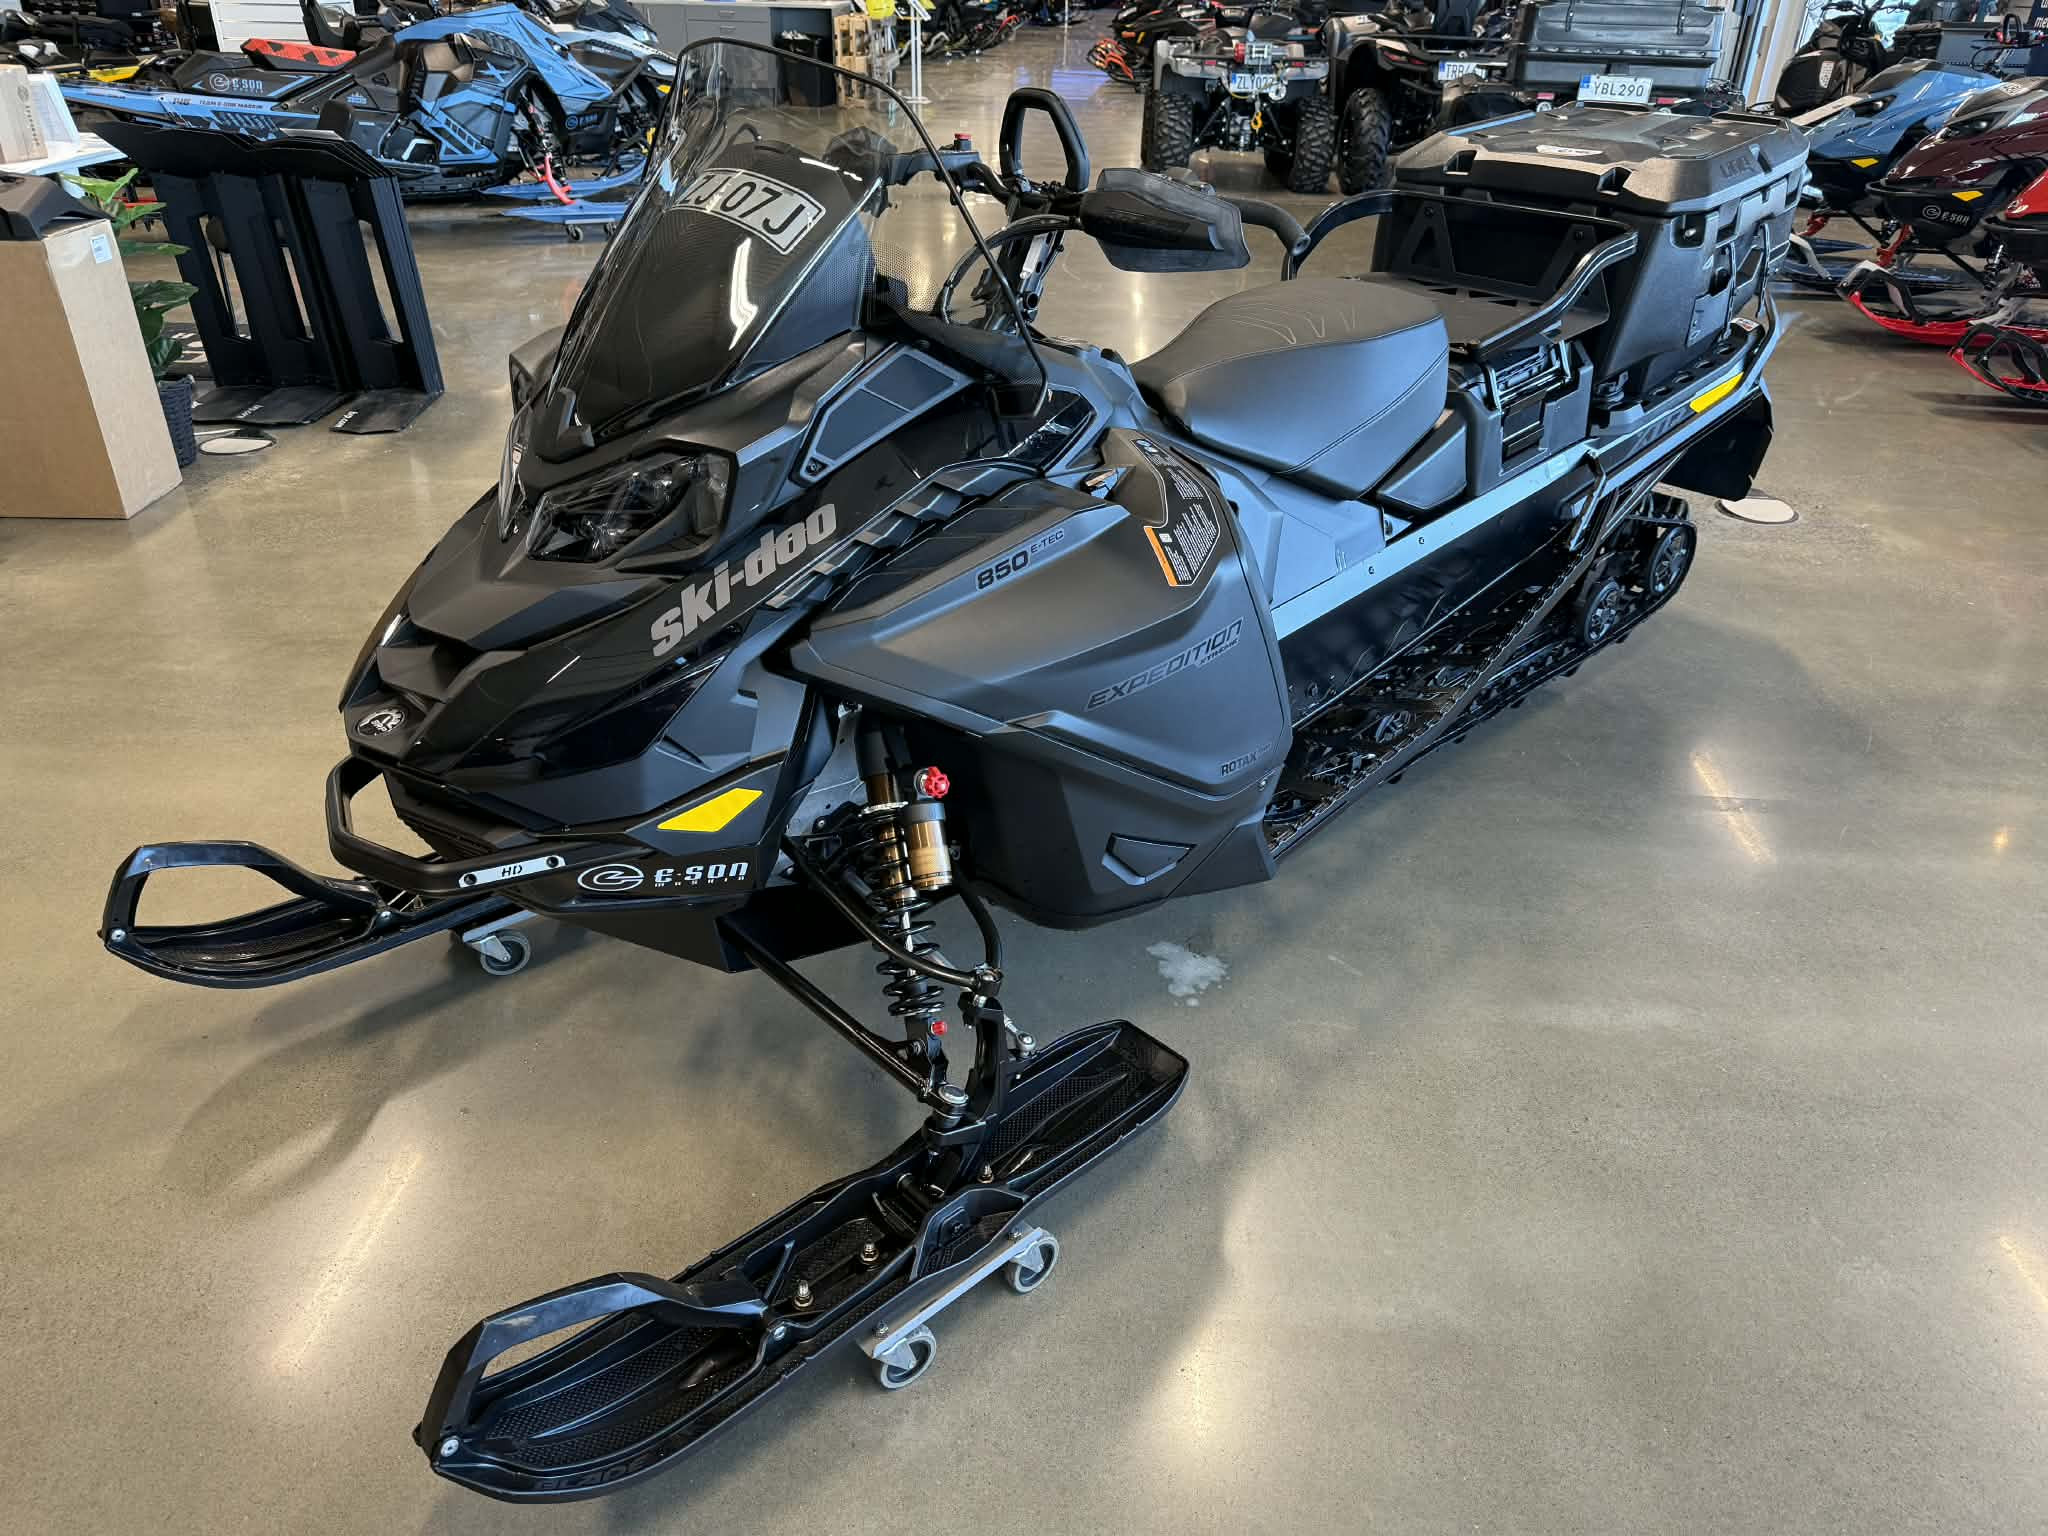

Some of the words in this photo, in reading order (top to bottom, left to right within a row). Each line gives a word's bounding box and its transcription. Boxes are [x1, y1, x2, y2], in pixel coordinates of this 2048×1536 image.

[1594, 82, 1644, 97] YBL290
[651, 504, 837, 657] ski-doo
[978, 550, 1028, 589] 850
[1030, 530, 1064, 553] E-TEC
[1087, 620, 1243, 709] EXPEDITION
[1220, 752, 1258, 777] ROTAX
[502, 865, 523, 877] HD
